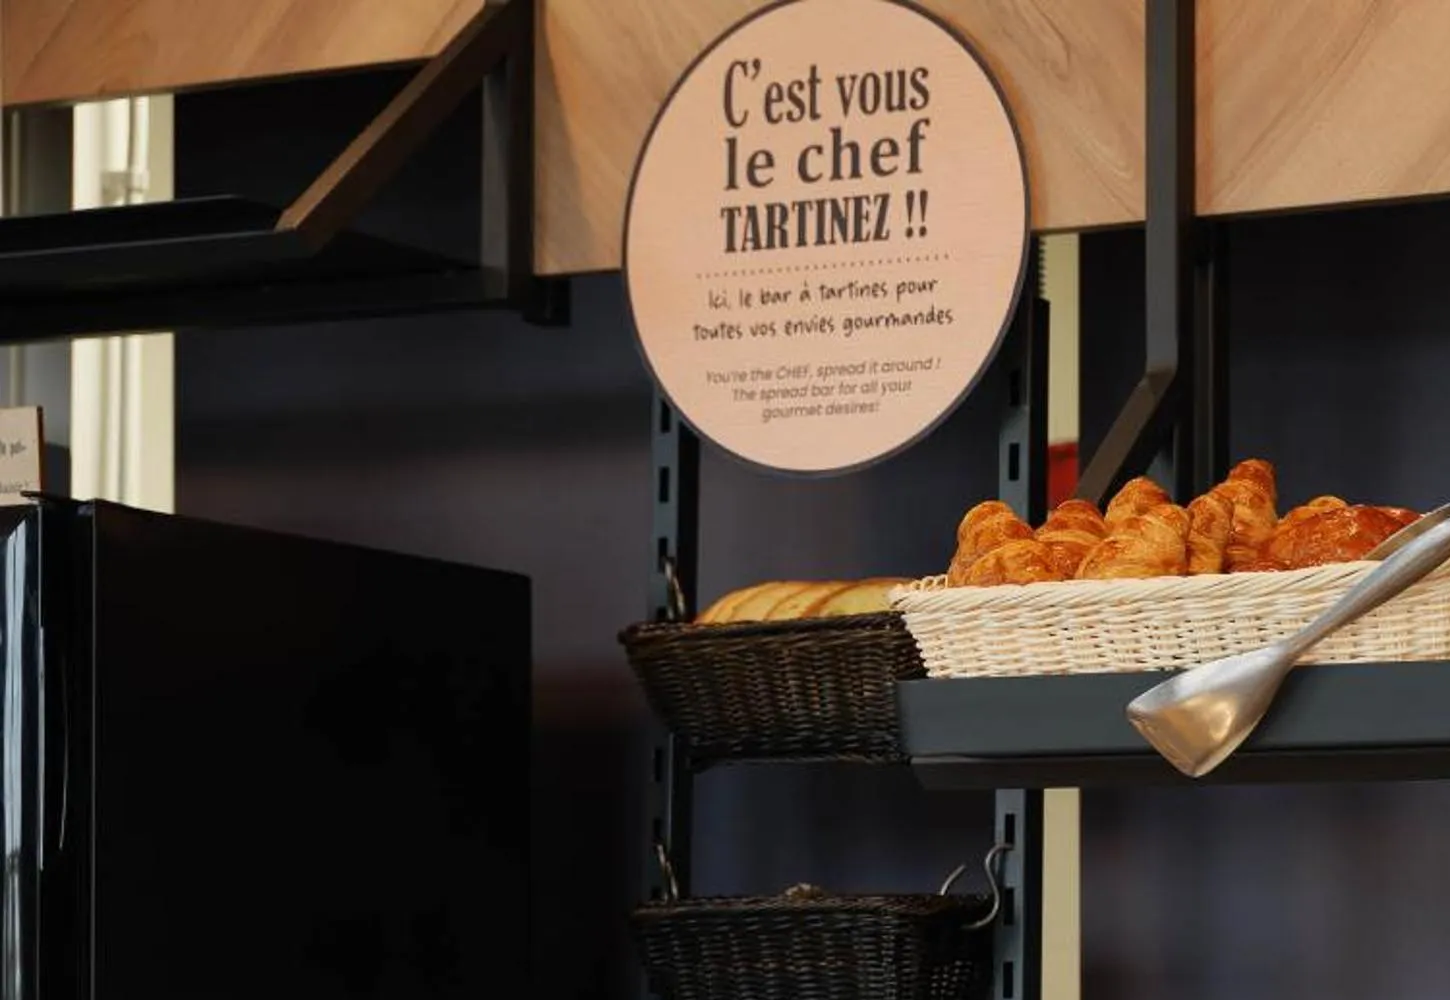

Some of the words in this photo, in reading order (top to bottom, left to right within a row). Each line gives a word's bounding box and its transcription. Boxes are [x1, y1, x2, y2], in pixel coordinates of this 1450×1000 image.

[836, 66, 930, 119] vous
[724, 136, 775, 190] le
[797, 117, 930, 184] chef
[720, 193, 891, 253] TARTINEZ
[904, 189, 929, 239] !!
[738, 288, 752, 308] le
[760, 287, 791, 306] bar
[800, 280, 811, 302] à
[819, 280, 888, 301] tartines
[896, 278, 938, 300] pour
[693, 323, 742, 341] toutes
[750, 321, 777, 337] vos
[784, 315, 835, 336] envies
[843, 305, 954, 337] gourmandes
[751, 368, 772, 382] the
[816, 361, 866, 379] spread
[868, 360, 879, 374] it
[881, 358, 932, 373] around
[731, 388, 755, 402] The
[760, 384, 807, 402] spread
[811, 383, 834, 398] bar
[838, 382, 857, 396] for
[860, 382, 878, 395] all
[881, 380, 912, 397] your
[761, 404, 823, 423] gourmet
